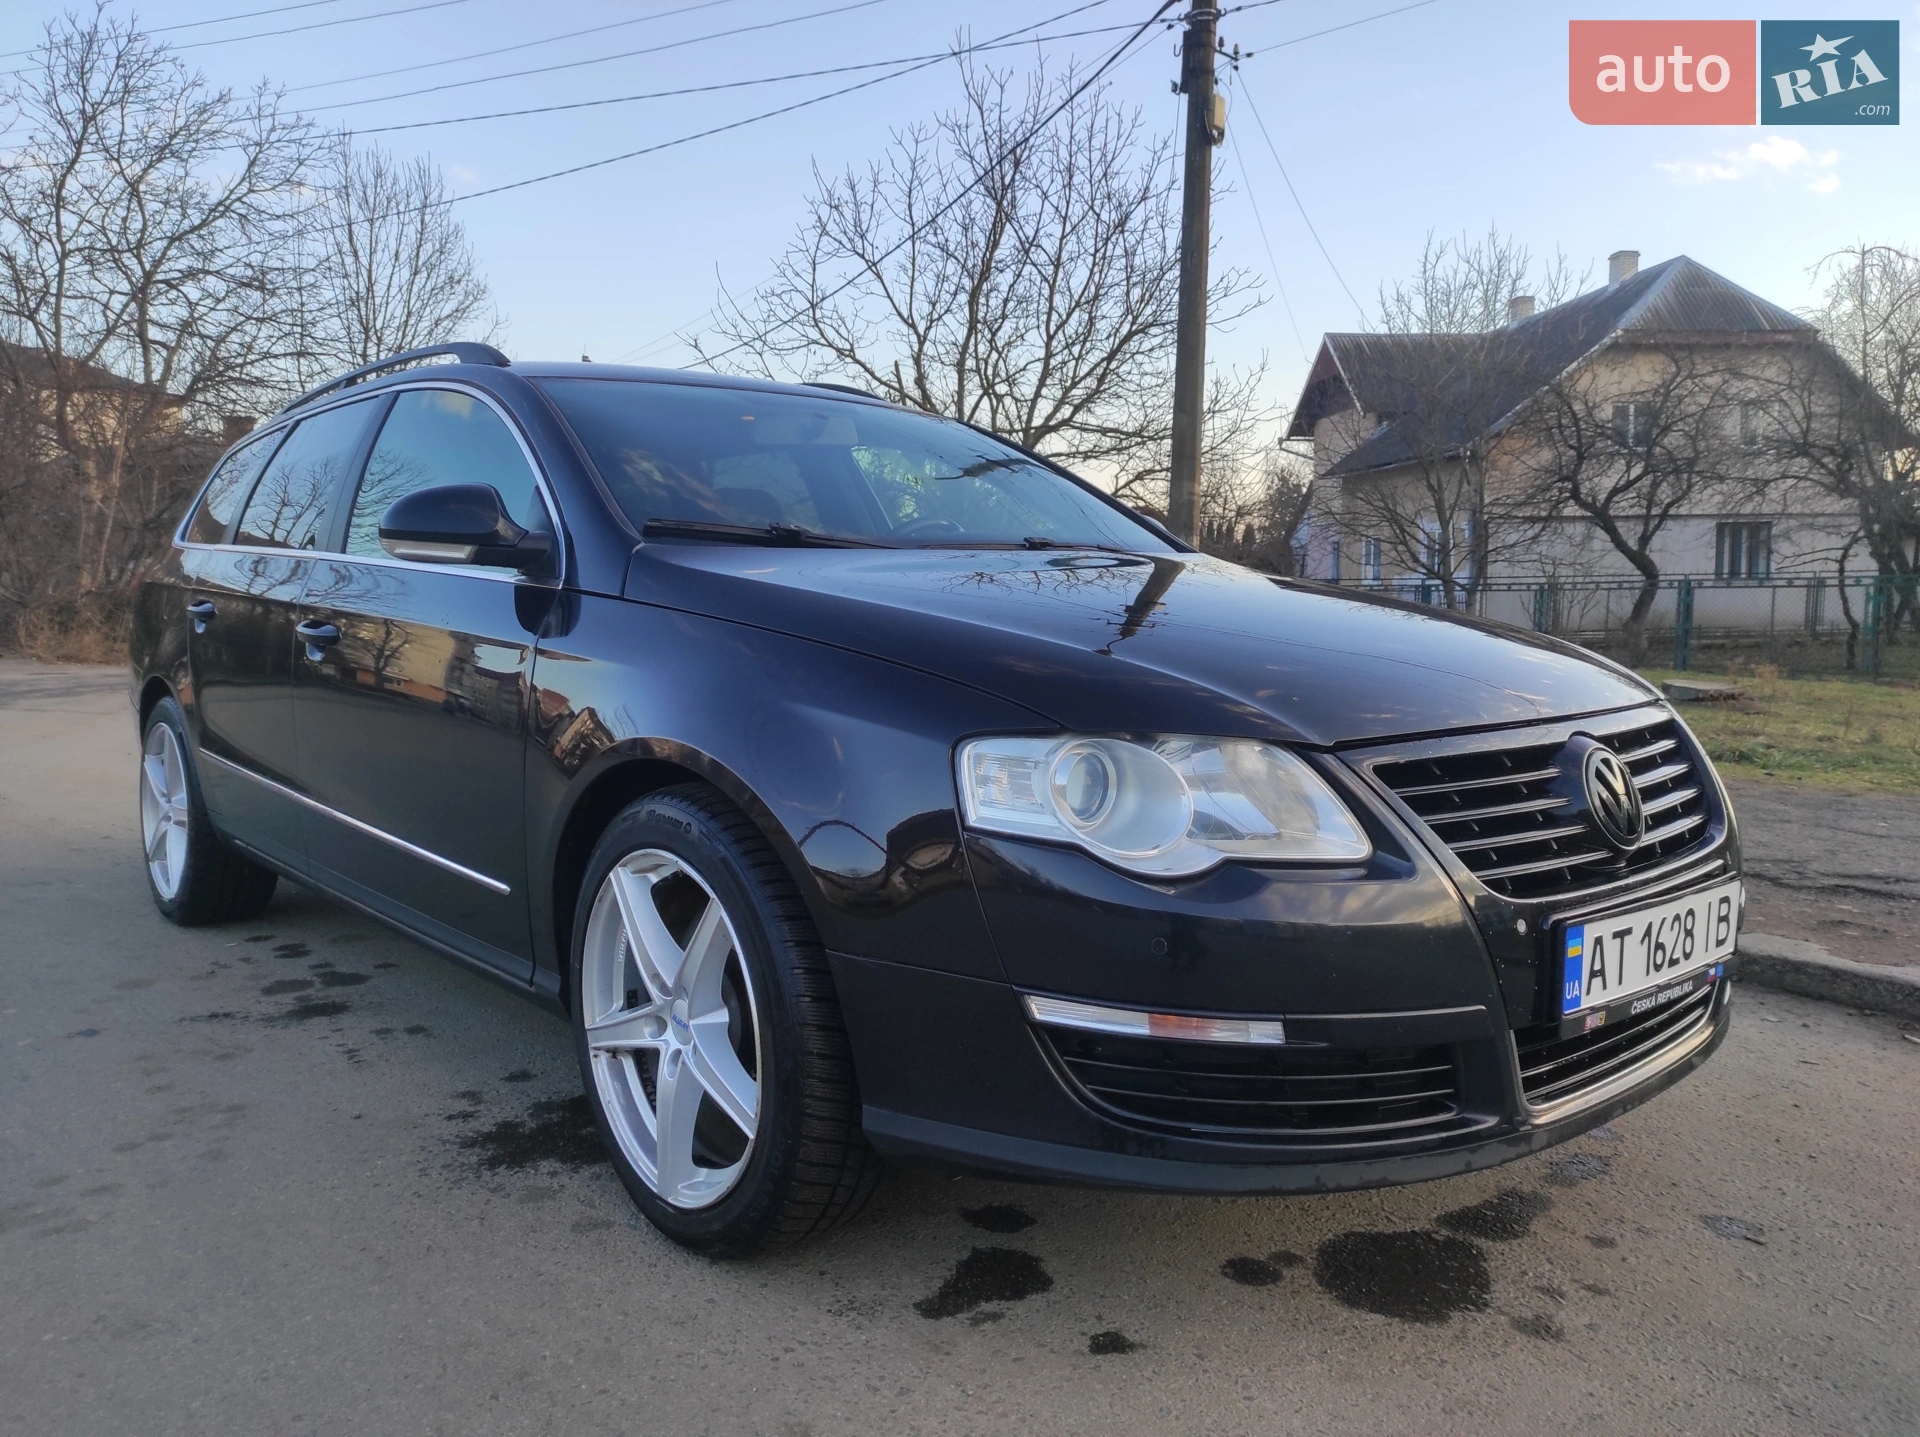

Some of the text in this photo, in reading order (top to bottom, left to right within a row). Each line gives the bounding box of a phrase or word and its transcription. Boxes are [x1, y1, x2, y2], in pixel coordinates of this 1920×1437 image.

[1586, 895, 1732, 996] AT 1628 IB
[1565, 979, 1580, 1000] UA
[1631, 992, 1656, 1015] ČESKÁ
